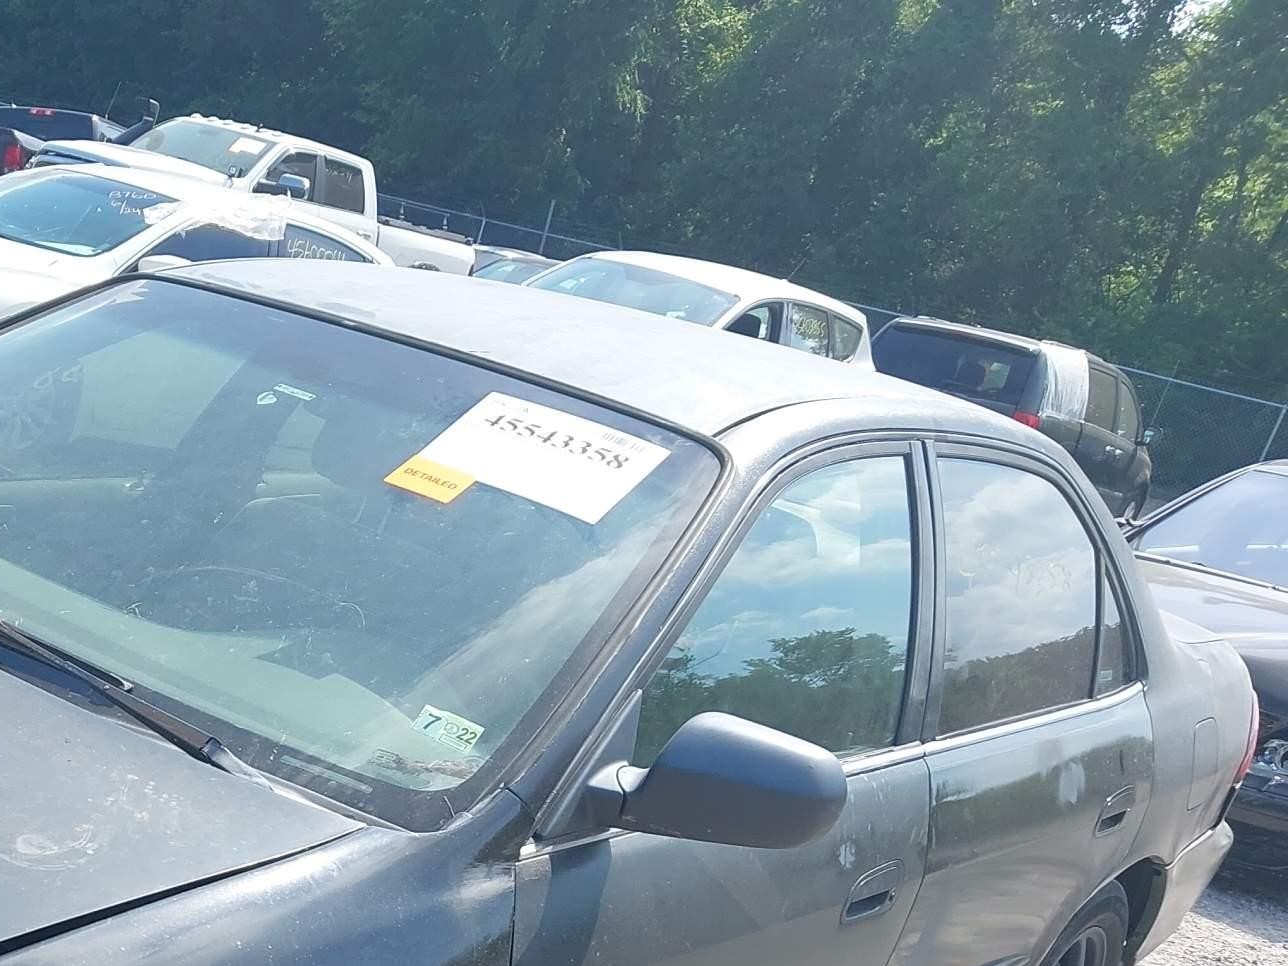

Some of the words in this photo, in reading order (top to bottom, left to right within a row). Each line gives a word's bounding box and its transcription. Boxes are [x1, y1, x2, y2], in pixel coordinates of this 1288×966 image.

[484, 414, 630, 470] 45543358
[403, 467, 459, 490] DETAILED
[423, 713, 442, 730] 7
[456, 727, 478, 745] 22
